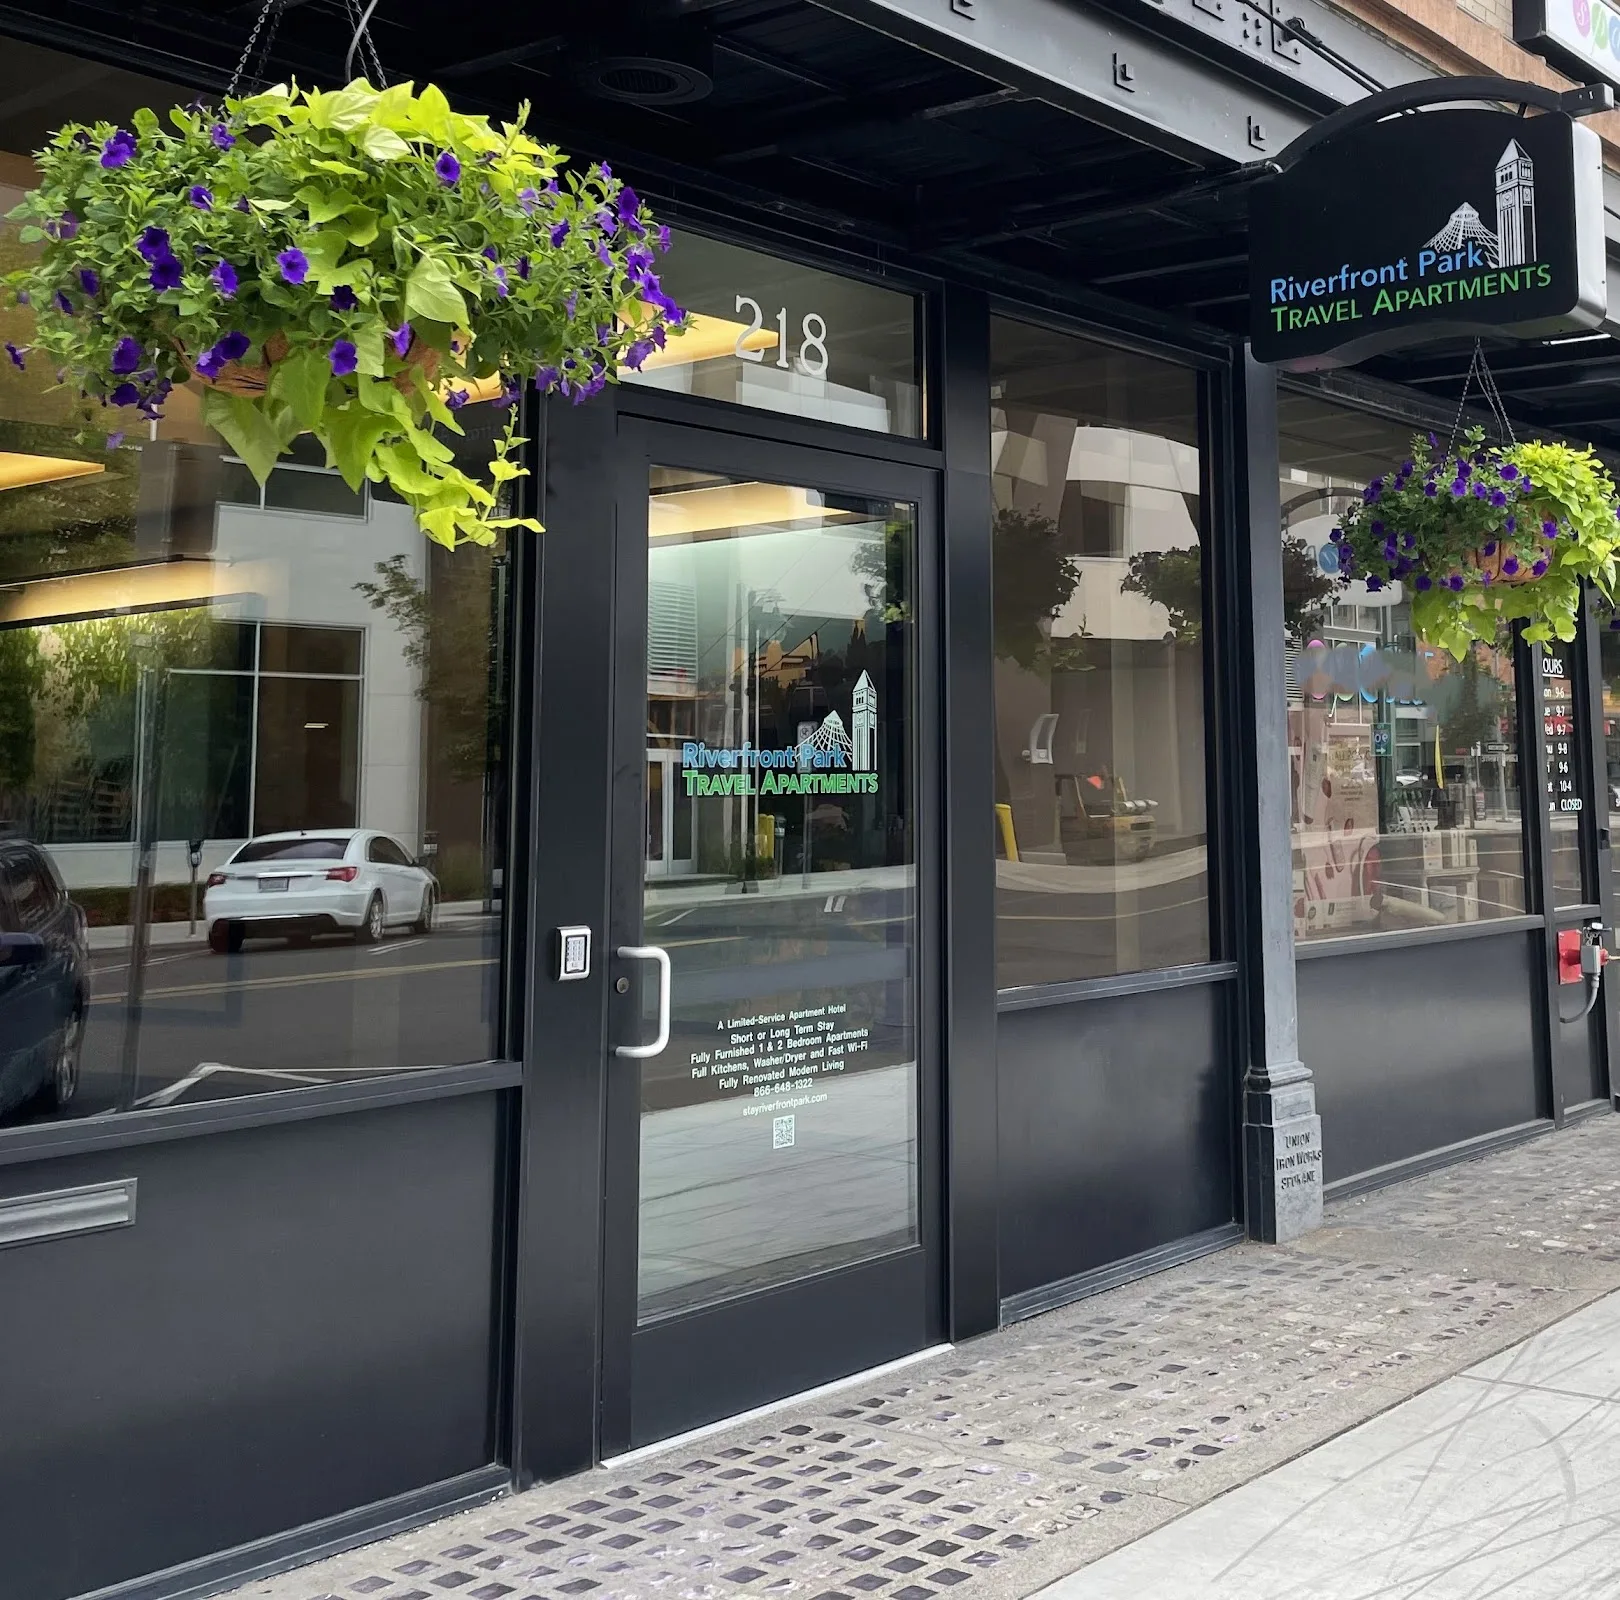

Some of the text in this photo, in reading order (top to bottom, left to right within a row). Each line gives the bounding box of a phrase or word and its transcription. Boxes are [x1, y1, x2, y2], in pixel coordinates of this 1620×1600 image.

[1271, 241, 1484, 304] Riverfront Park
[1271, 264, 1551, 332] TRAVEL APARTMENTS
[735, 294, 829, 376] 218
[1542, 657, 1563, 675] OURS
[682, 742, 848, 769] Riverfront Park
[682, 770, 879, 796] TRAVEL APARTMENTS
[1560, 797, 1583, 811] CLOSED
[717, 1003, 847, 1031] A Limited-Service Apartment Hotel
[690, 1027, 869, 1065] Fully Furnished 1 & 2 Bedroom Apartments
[730, 1021, 835, 1045] Short or Long Term Stay
[691, 1040, 869, 1079] Full Kitchens, Washer/Dryer and Fast Wi-Fi
[718, 1060, 845, 1090] Fully Renovated Modern Living
[753, 1077, 813, 1098] 866-648-1322
[742, 1092, 828, 1117] stayriverfrontpark.com
[1284, 1132, 1311, 1149] UNION
[1275, 1149, 1322, 1171] IRON WORKS
